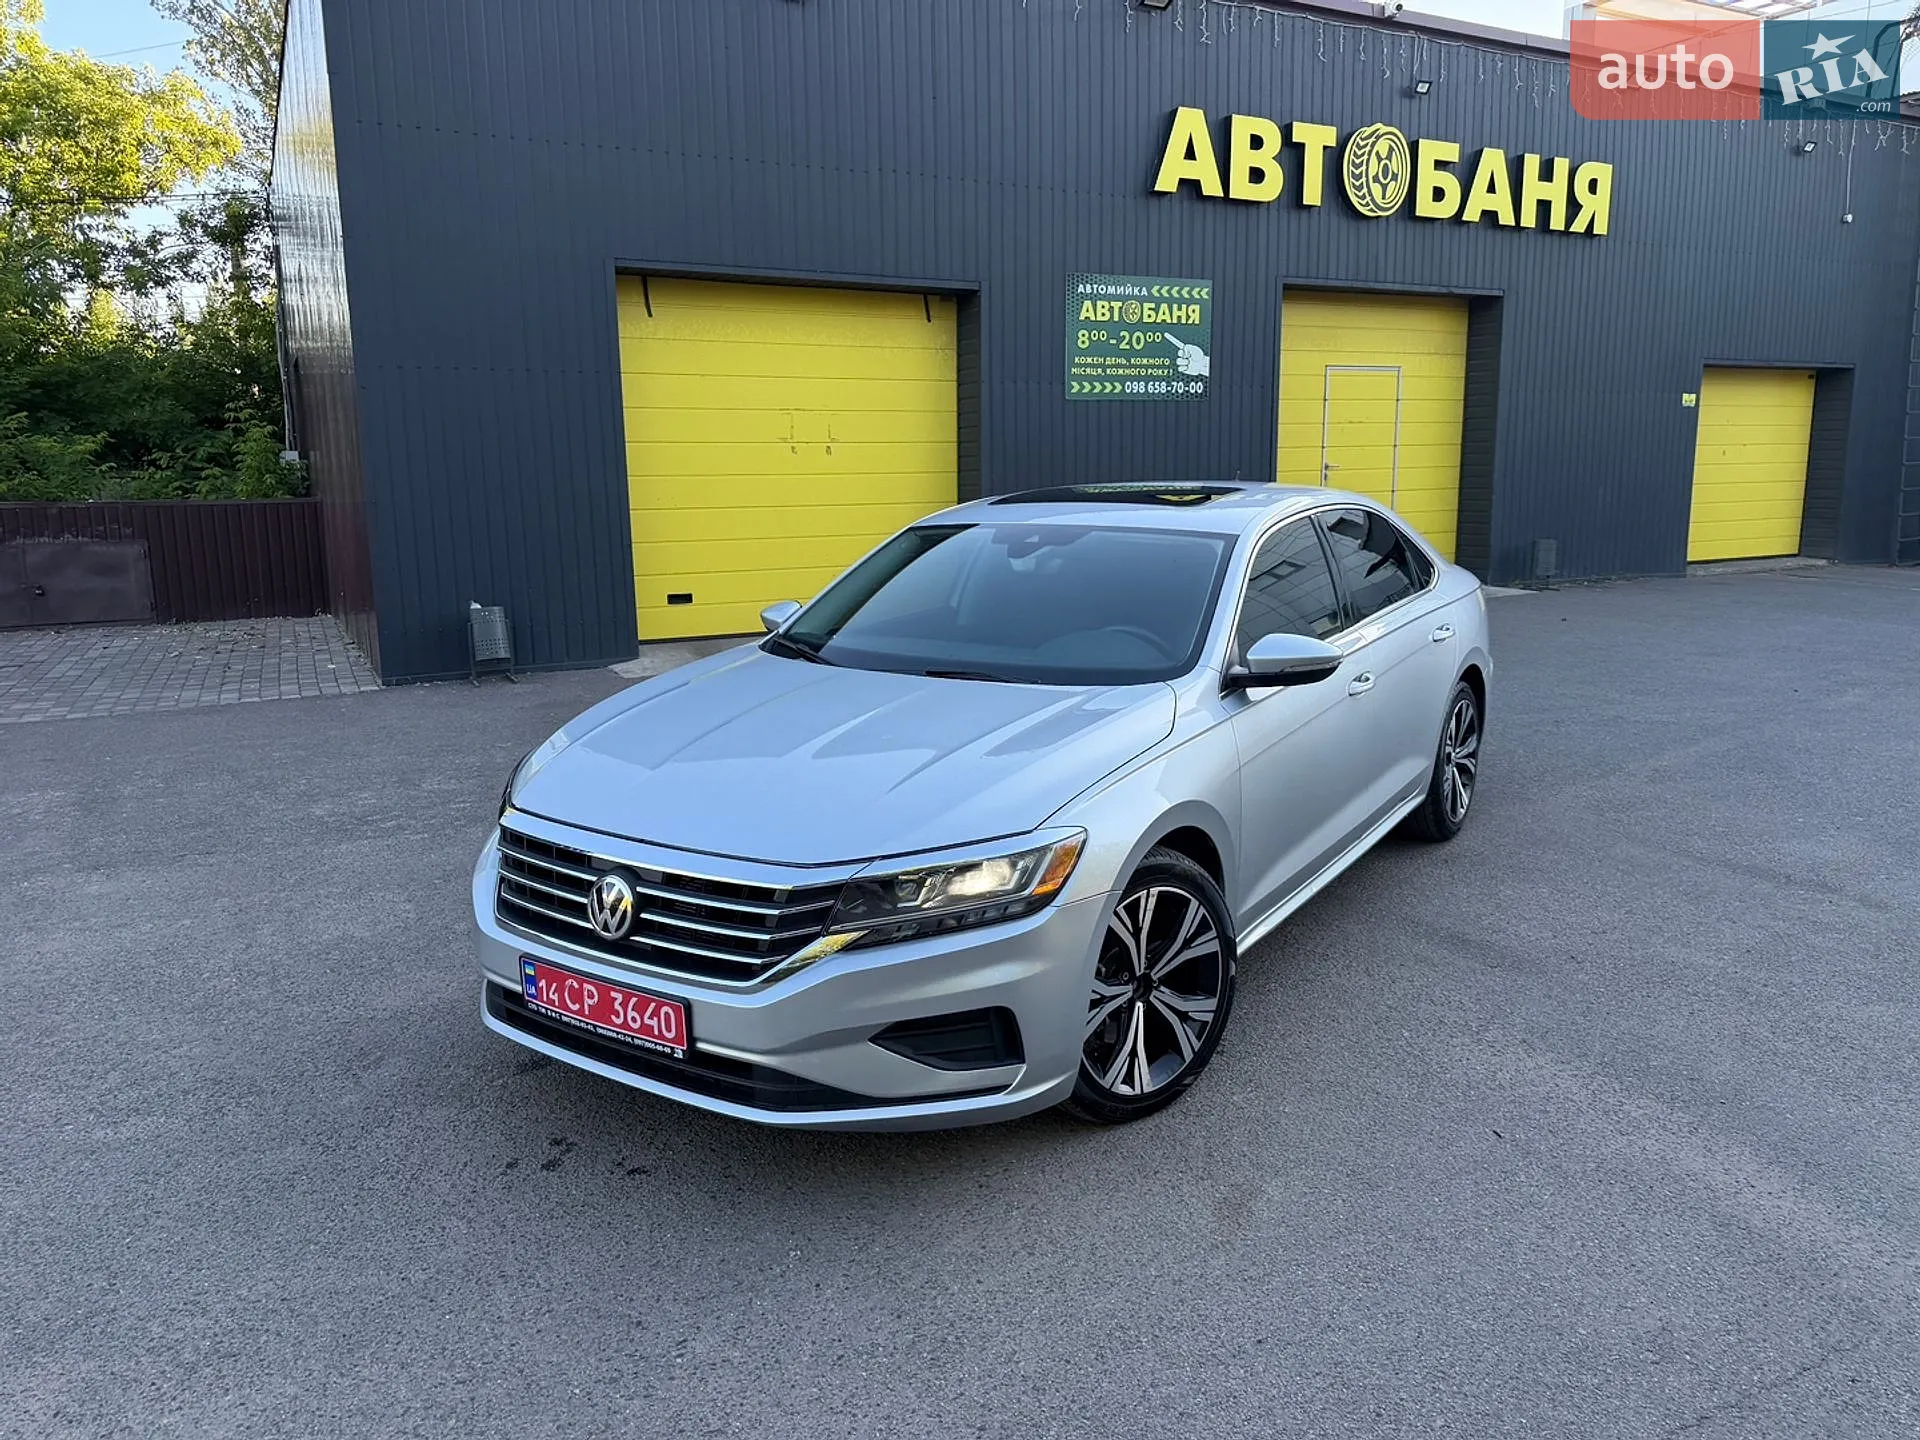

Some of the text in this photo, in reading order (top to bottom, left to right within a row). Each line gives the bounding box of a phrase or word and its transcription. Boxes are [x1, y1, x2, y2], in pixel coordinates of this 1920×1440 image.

[1077, 283, 1148, 297] АВТОМИЙКА
[1074, 356, 1104, 365] КОЖЕН
[1131, 358, 1171, 366] КОЖНОГО
[1106, 368, 1147, 376] КОЖНОГО
[1124, 381, 1204, 394] 098 658-70-00
[526, 983, 537, 996] UA
[610, 990, 676, 1039] 3640
